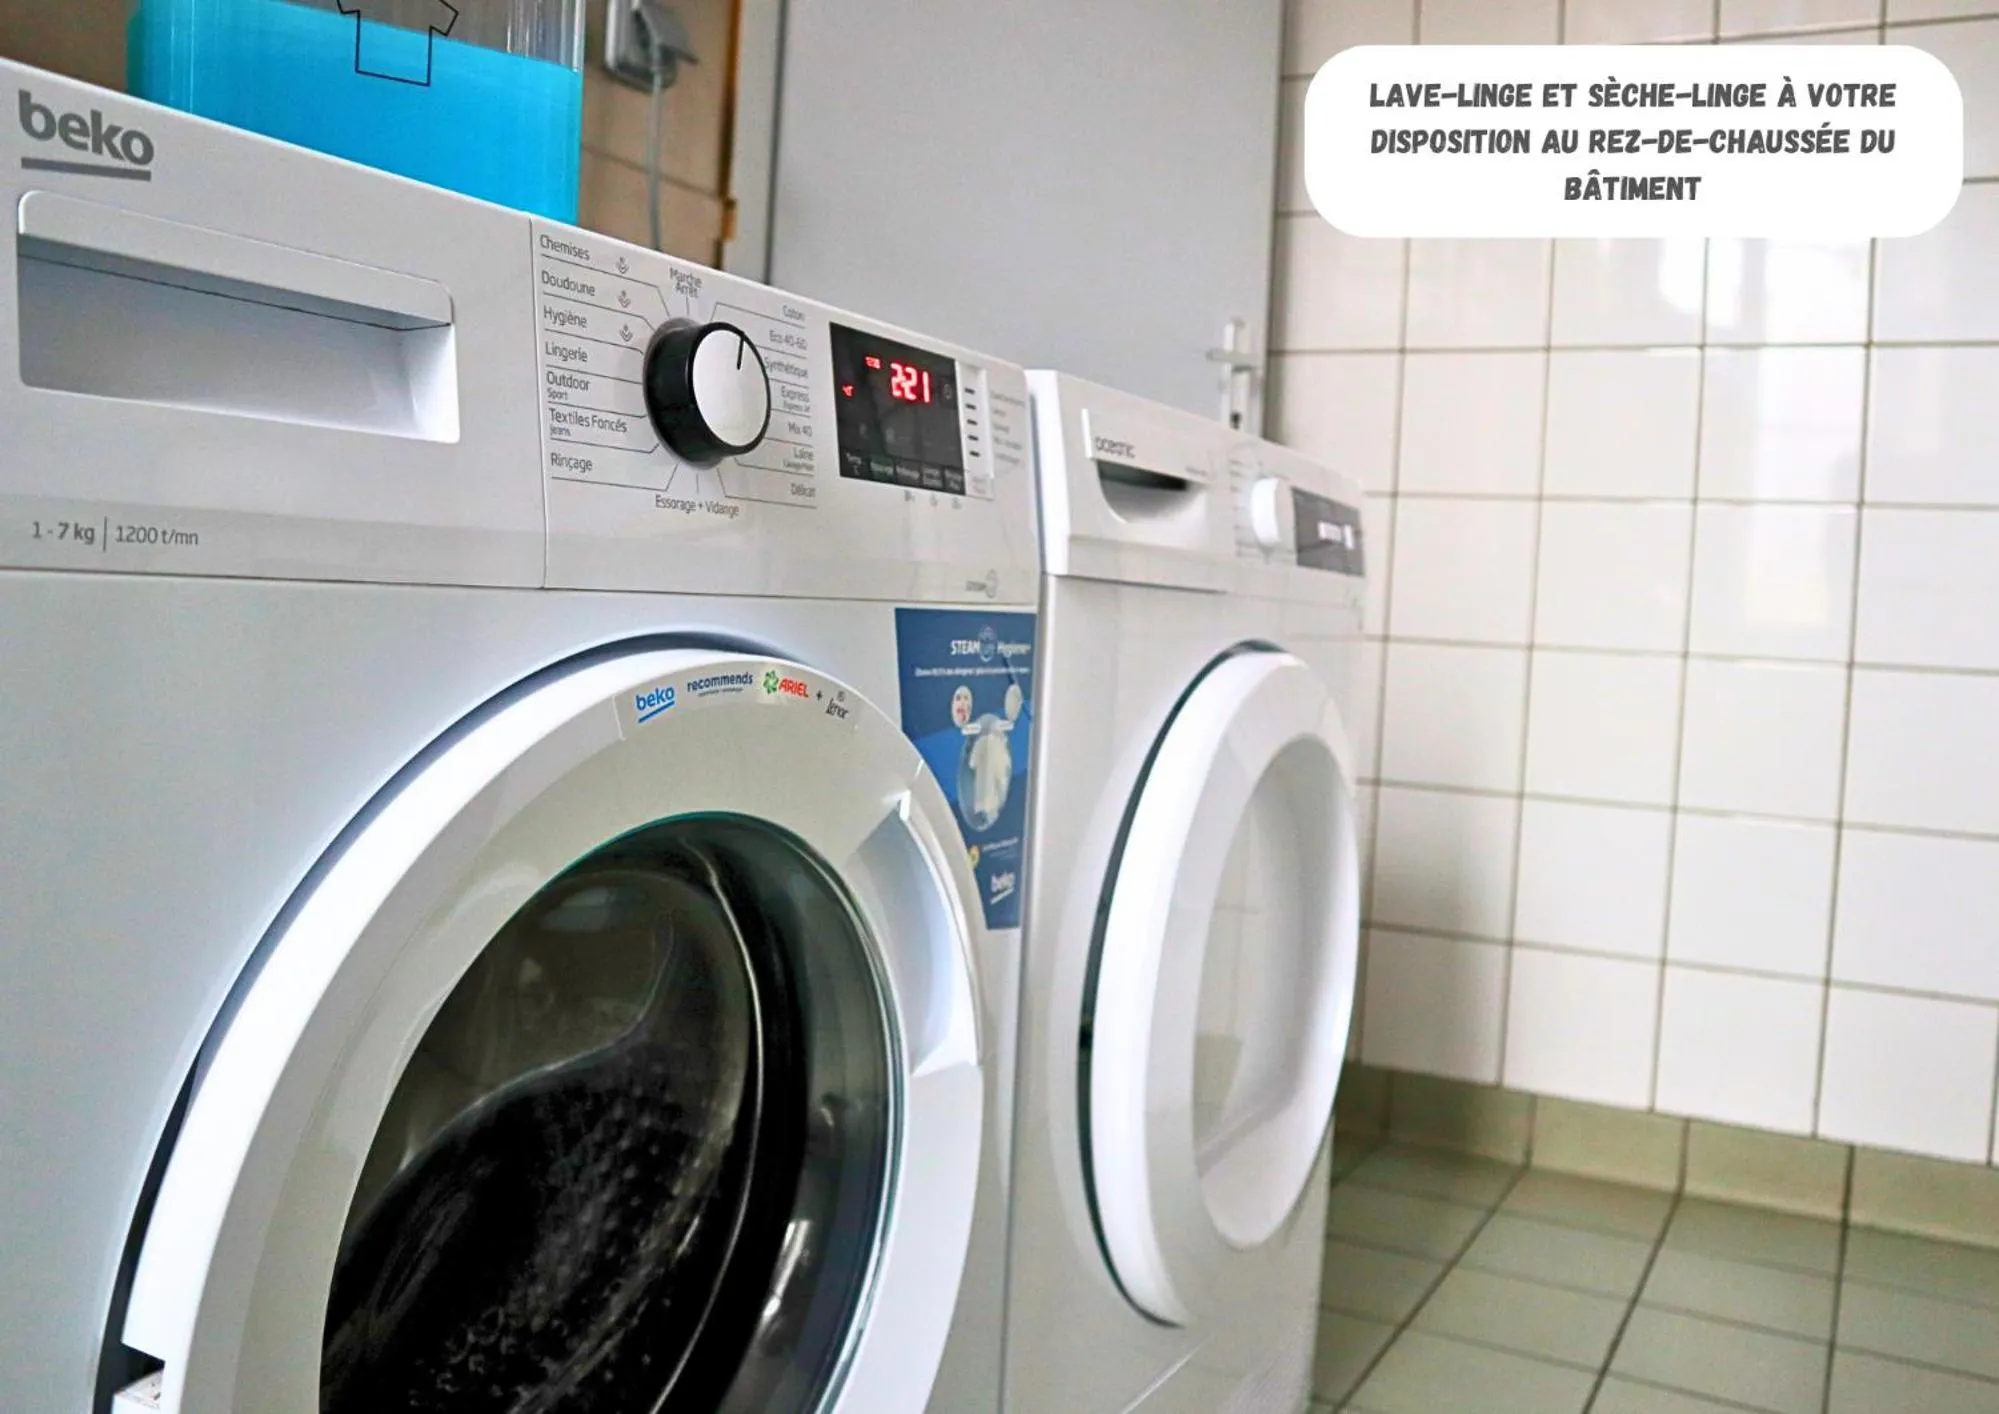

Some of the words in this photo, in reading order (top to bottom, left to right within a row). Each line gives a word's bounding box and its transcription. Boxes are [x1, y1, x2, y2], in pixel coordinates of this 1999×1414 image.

[18, 88, 155, 165] beko
[540, 235, 590, 260] Chemises
[541, 270, 595, 296] Doudoune
[669, 267, 702, 286] Marche
[543, 305, 588, 328] Hygiène
[545, 342, 588, 362] Lingerie
[546, 371, 590, 391] Outdoor
[547, 387, 569, 400] Sport
[549, 408, 590, 427] Textiles
[591, 415, 628, 433] Foncés
[551, 453, 592, 473] Rinçage
[655, 495, 697, 514] Essorage
[706, 501, 739, 518] Vidange
[32, 521, 42, 539] 1
[57, 522, 69, 540] 7
[74, 523, 95, 546] kg
[115, 525, 158, 544] 1200
[161, 528, 199, 545] t/mn
[951, 639, 981, 655] STEAM
[687, 672, 753, 692] recommends
[778, 677, 809, 698] ARIEL
[636, 684, 675, 711] beko
